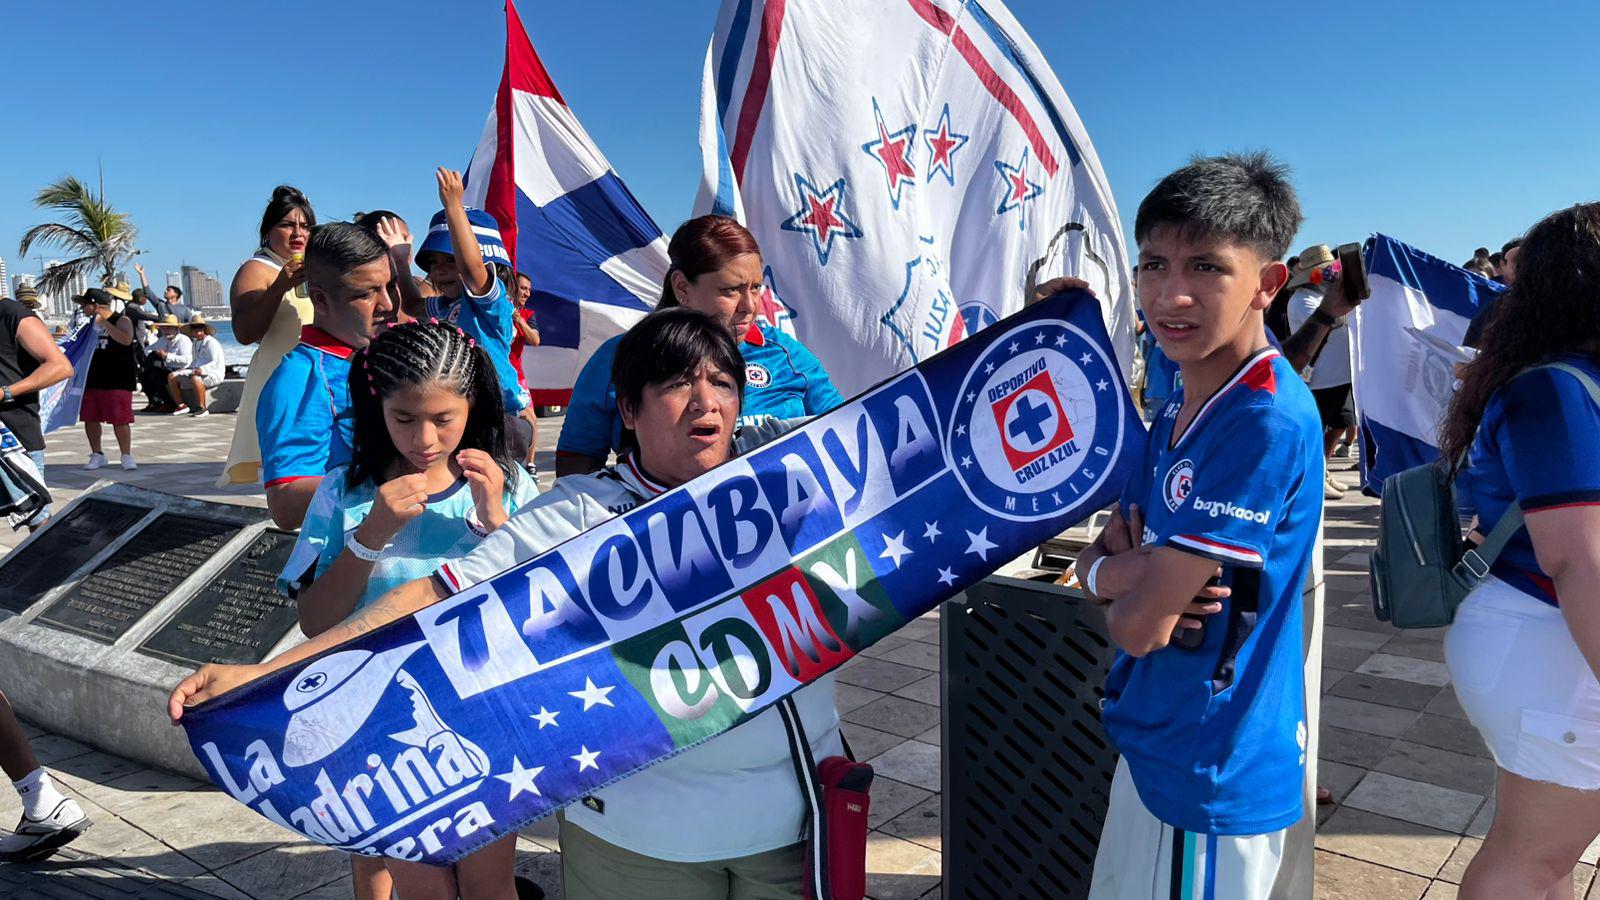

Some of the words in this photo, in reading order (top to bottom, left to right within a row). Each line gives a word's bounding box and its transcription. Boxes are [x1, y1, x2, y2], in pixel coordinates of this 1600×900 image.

[987, 356, 1047, 403] DEPORTIVO
[1014, 459, 1049, 485] CRUZ
[1049, 440, 1081, 468] AZUL
[433, 395, 938, 672] TACUBAYA
[1192, 496, 1271, 525] bankaool
[650, 547, 889, 721] CDMX
[201, 739, 286, 806] La
